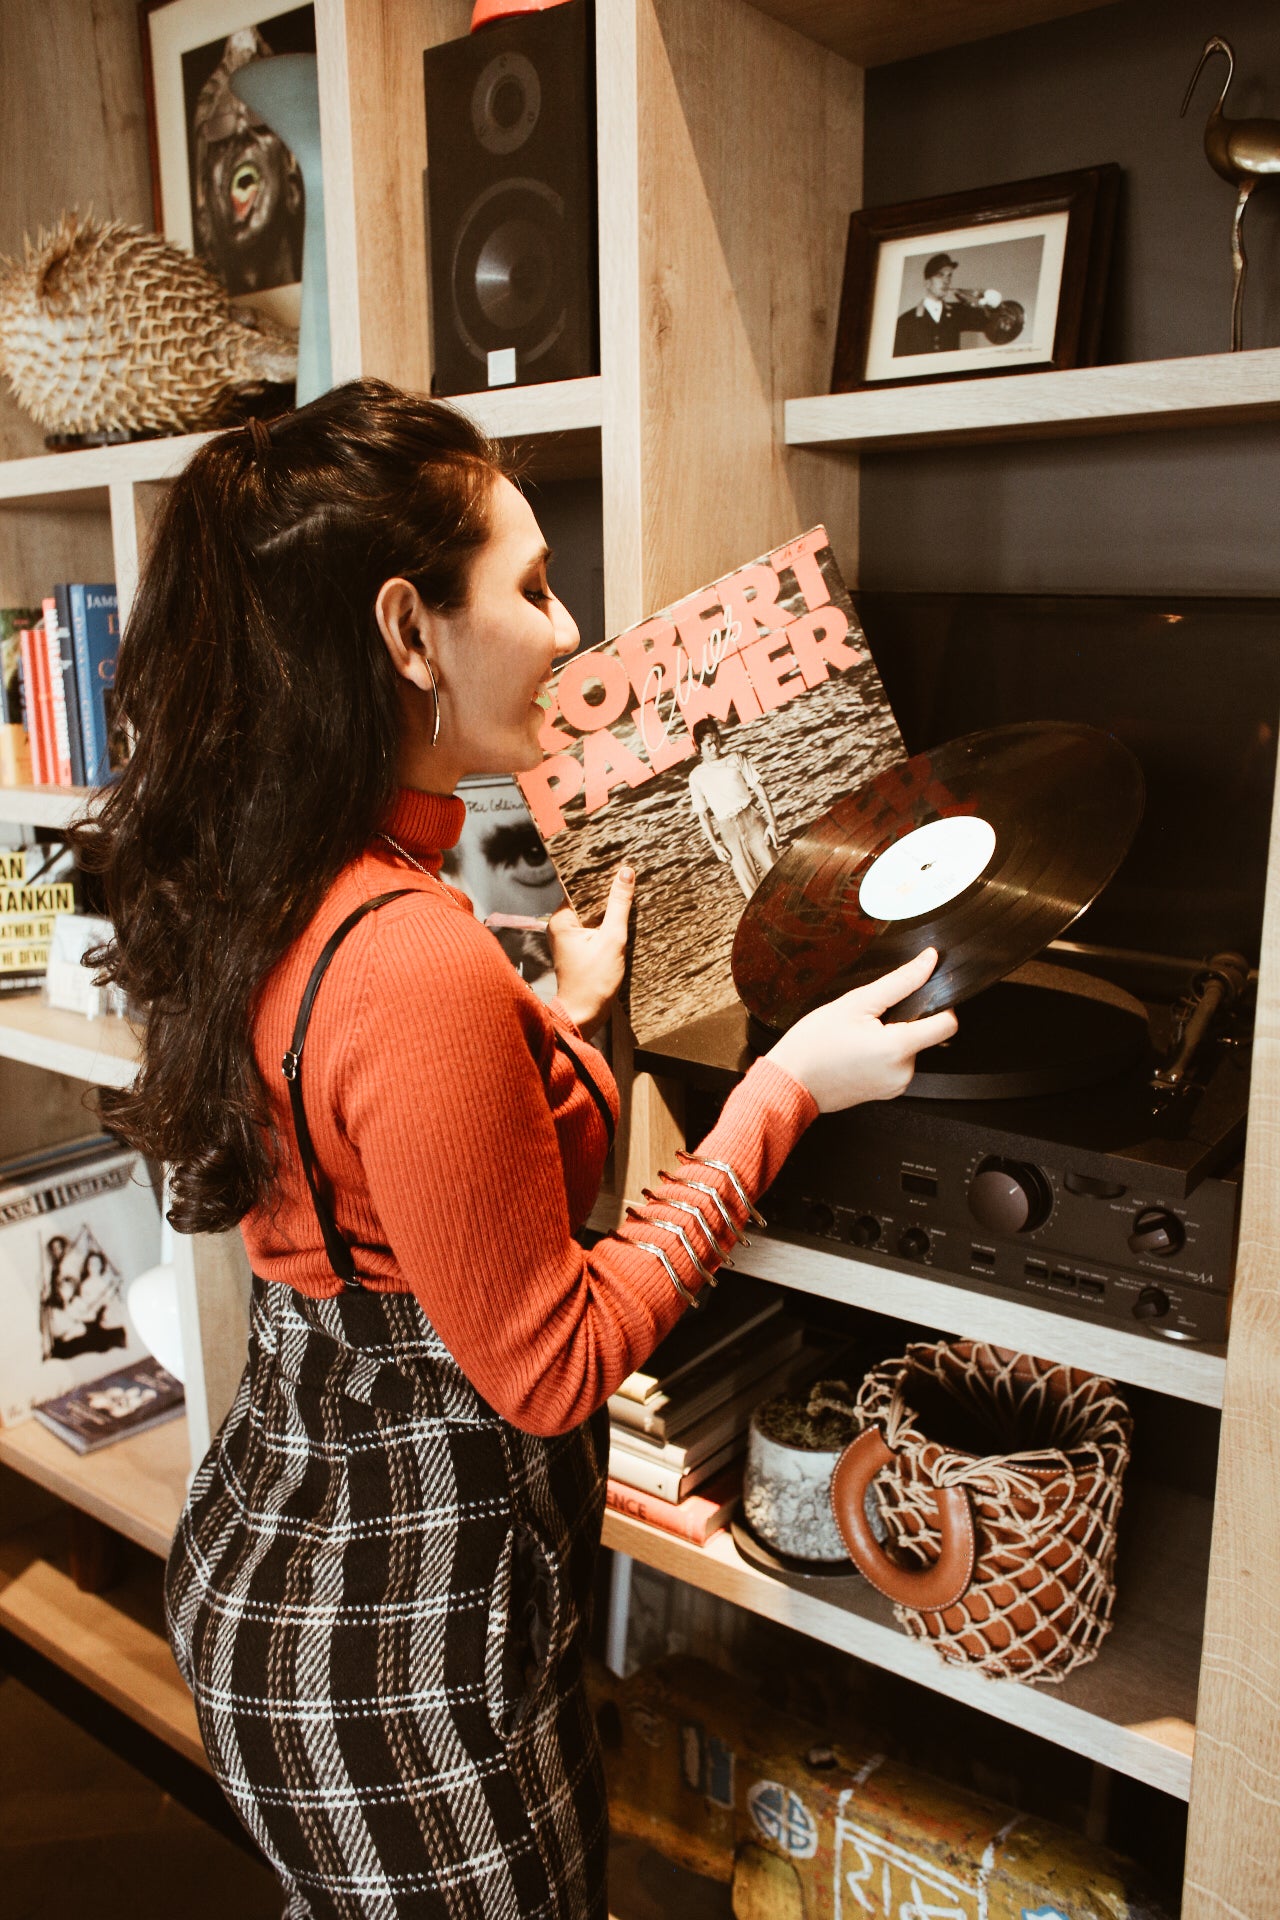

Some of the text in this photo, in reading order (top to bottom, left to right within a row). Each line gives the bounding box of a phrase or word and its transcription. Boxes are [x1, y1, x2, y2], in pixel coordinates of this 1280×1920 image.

[517, 605, 864, 839] PALMER
[639, 603, 743, 752] Clues
[0, 888, 69, 912] ANKIN
